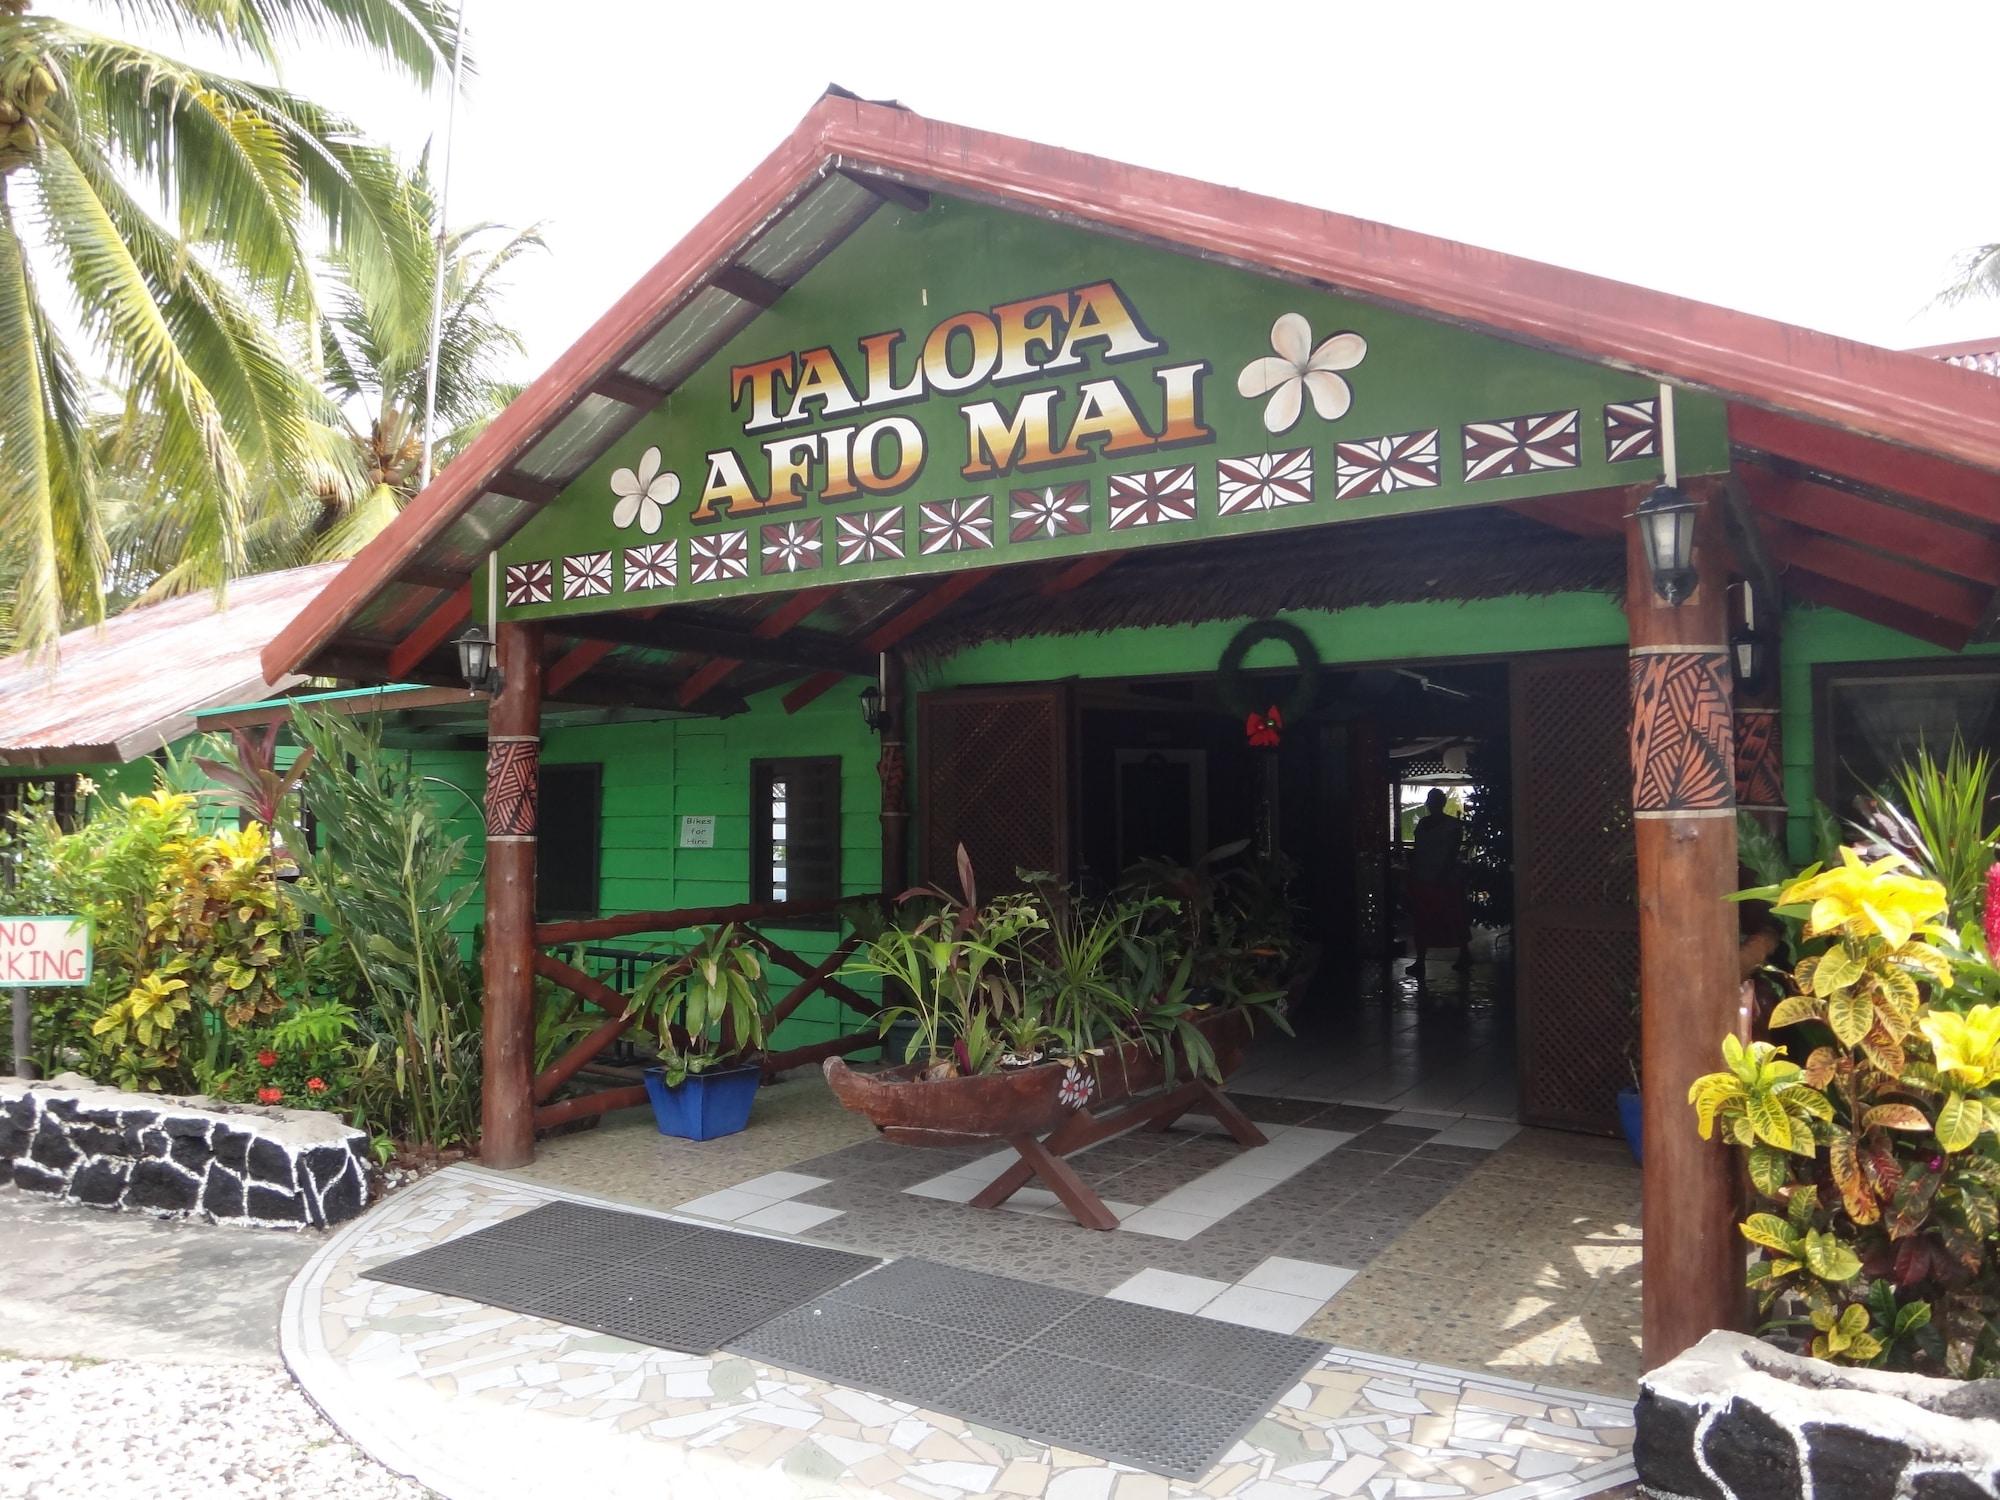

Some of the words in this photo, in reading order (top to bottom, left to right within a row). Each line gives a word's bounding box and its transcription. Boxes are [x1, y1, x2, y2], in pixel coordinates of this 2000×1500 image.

[731, 279, 1168, 437] TALOFA
[690, 416, 928, 526] AFIO
[960, 362, 1216, 481] MAI
[686, 817, 712, 825] Bikes
[0, 922, 36, 946] NO
[0, 949, 86, 980] KING
